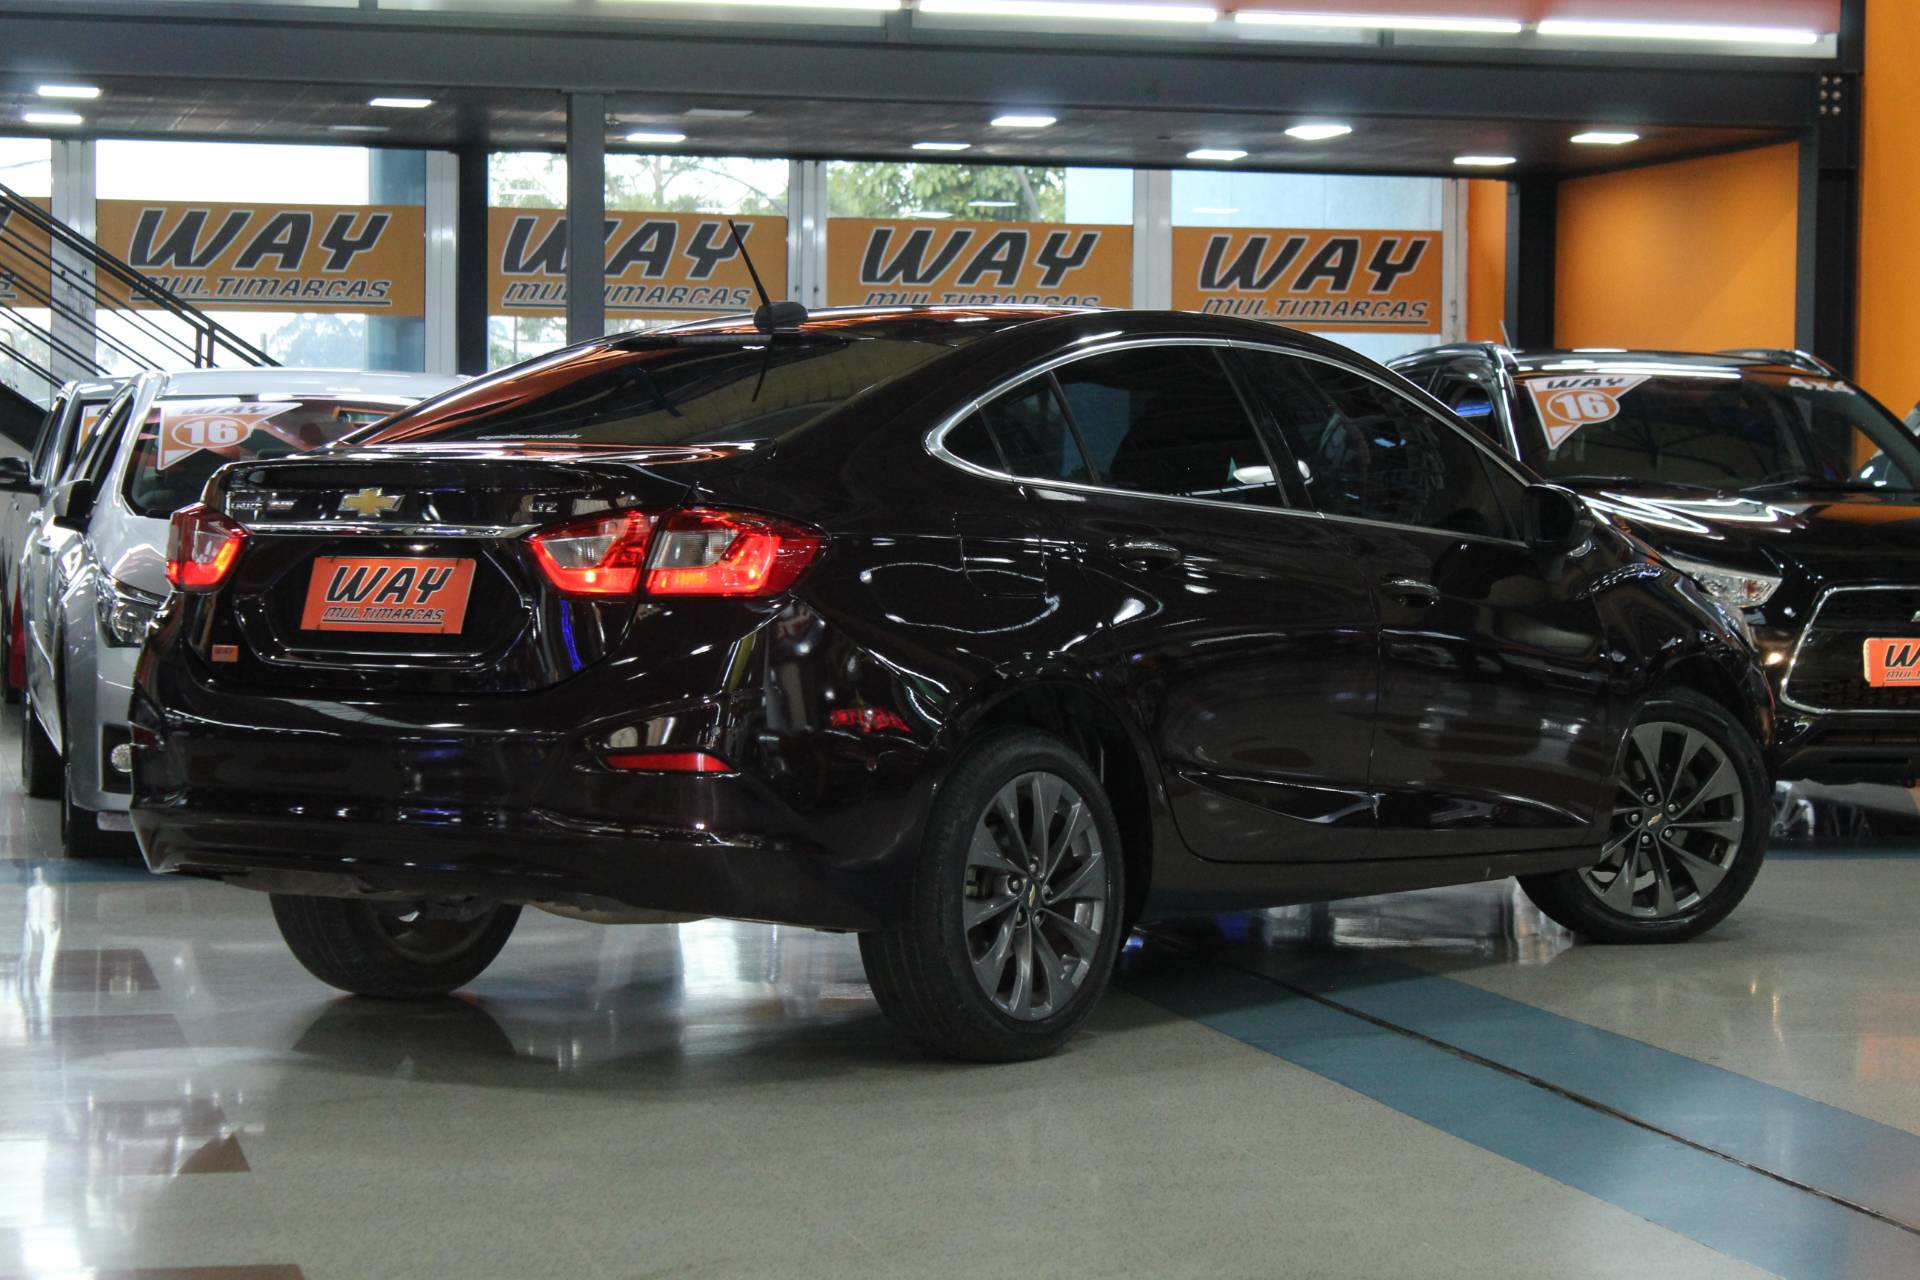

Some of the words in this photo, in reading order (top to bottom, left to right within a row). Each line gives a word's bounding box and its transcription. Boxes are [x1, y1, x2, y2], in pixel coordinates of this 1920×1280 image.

[128, 207, 392, 273] WAY
[501, 214, 753, 281] WAY
[859, 226, 1101, 288] WAY
[1198, 233, 1431, 294] WAY
[503, 281, 751, 306] MUIMARCAS
[1201, 298, 1429, 318] MULTIMARCAS
[1547, 378, 1625, 389] WAY
[1555, 392, 1611, 420] 16
[183, 420, 239, 445] 16
[325, 565, 455, 605] WAY
[322, 606, 446, 620] MULTIMARCAS
